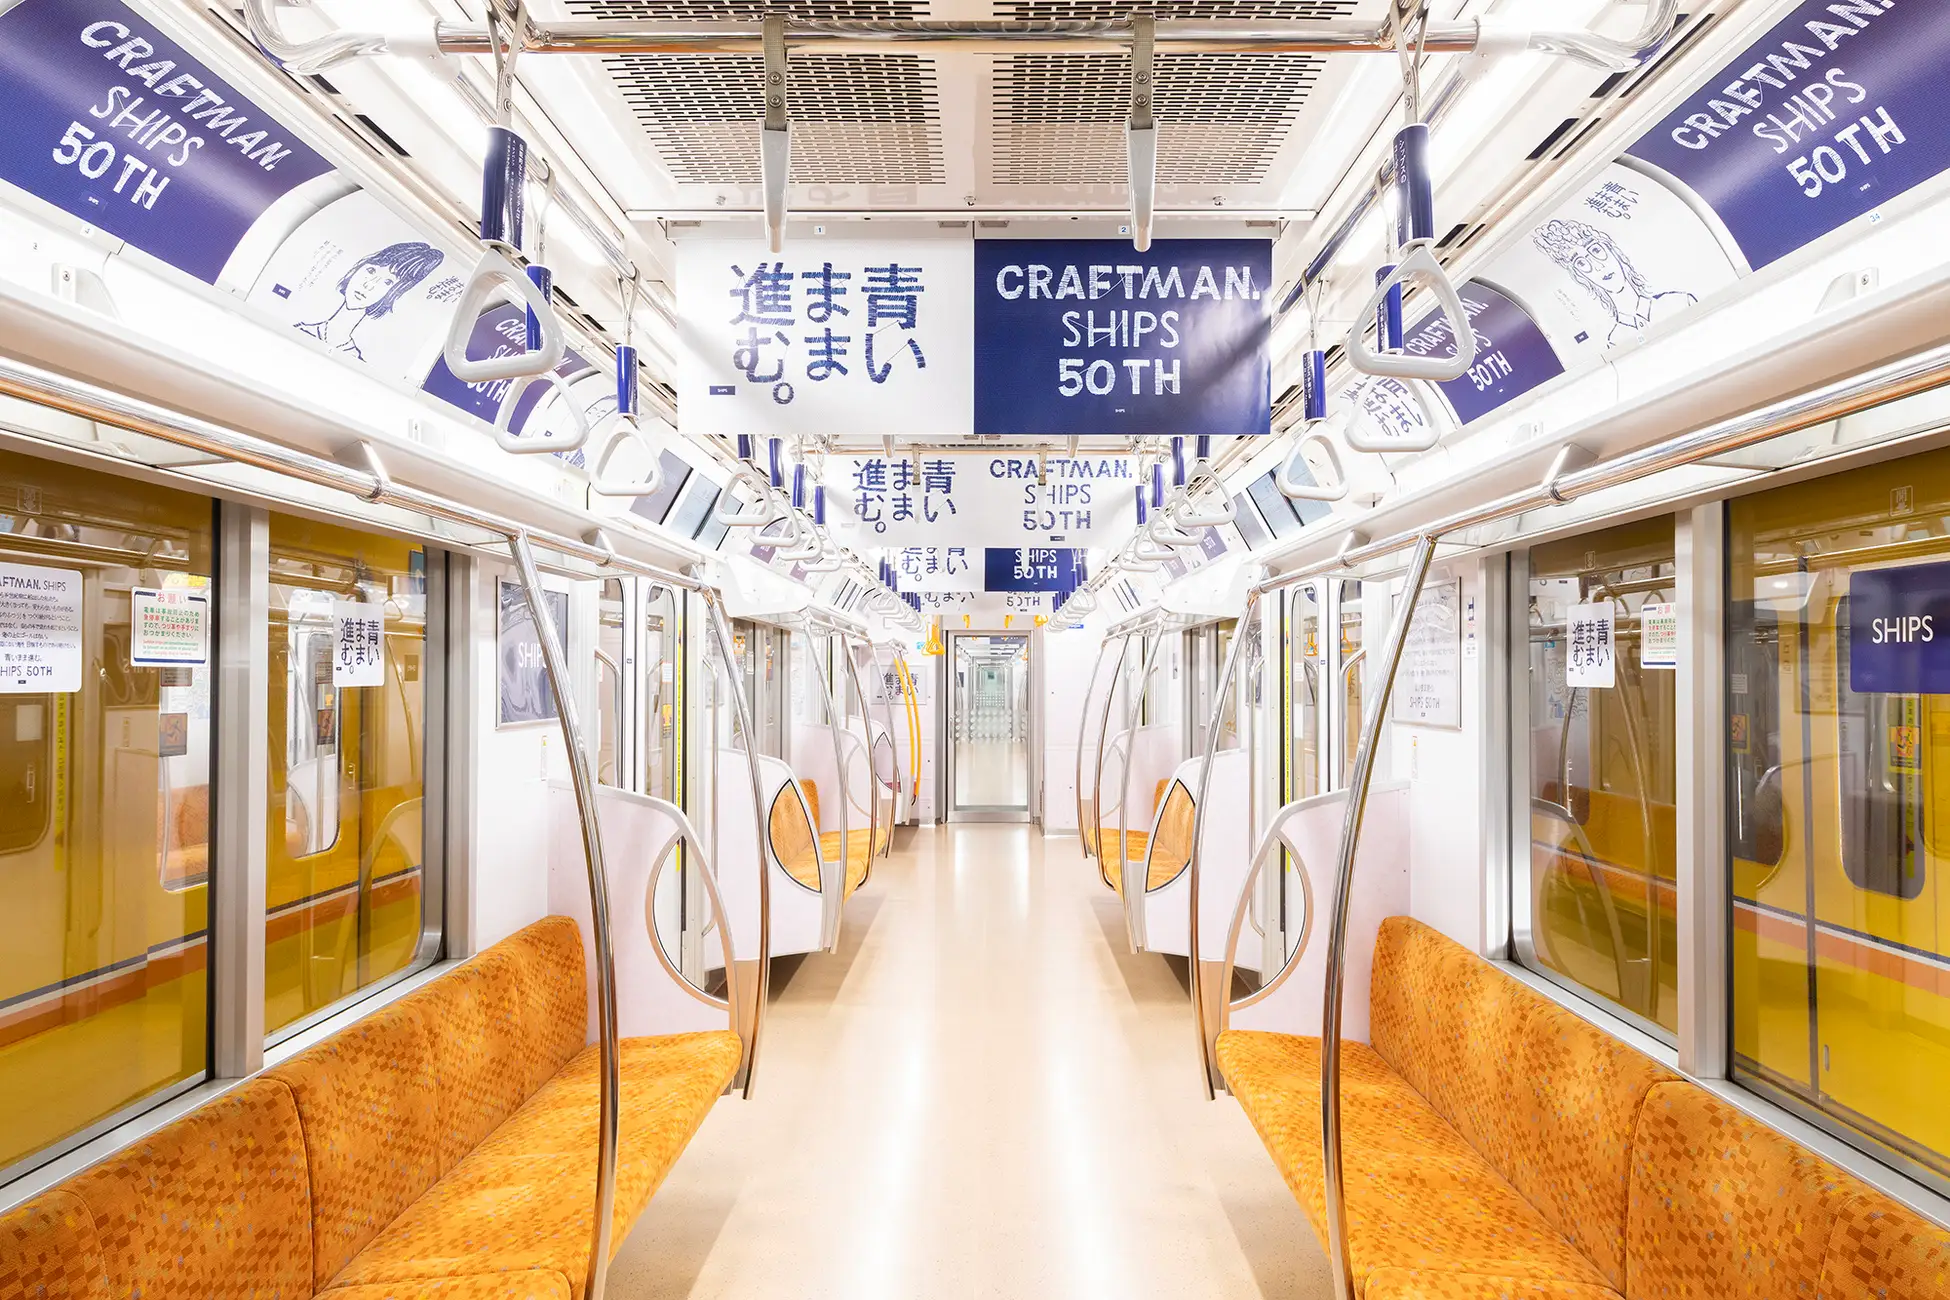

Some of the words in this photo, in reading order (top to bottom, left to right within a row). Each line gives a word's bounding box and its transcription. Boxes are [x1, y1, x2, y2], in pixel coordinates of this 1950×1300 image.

[80, 20, 293, 171] CRAFTMAN.
[1671, 0, 1896, 149] CRAFTMAN.
[89, 85, 205, 167] SHIPS
[1752, 67, 1866, 154] SHIPS
[52, 120, 171, 211] 50TH
[1786, 106, 1907, 198] 50TH
[1120, 226, 1127, 234] 2
[995, 263, 1261, 300] CRAFTMAN.
[729, 261, 795, 405] 進む。
[801, 262, 851, 381] まま
[861, 262, 926, 384] 青い
[1061, 309, 1180, 348] SHIPS
[1057, 357, 1182, 397] 50TH
[1466, 350, 1513, 392] 50TH
[852, 459, 887, 533] 進む。
[922, 459, 956, 523] 青い
[0, 576, 41, 590] FTMAN.
[43, 580, 67, 592] SHIPS
[355, 618, 366, 666] まま
[366, 619, 380, 666] 青い
[1585, 619, 1596, 667] まま
[1596, 618, 1610, 667] 青い
[1872, 615, 1934, 645] SHIPS
[0, 665, 22, 677] HIPS
[26, 665, 53, 677] 50TH
